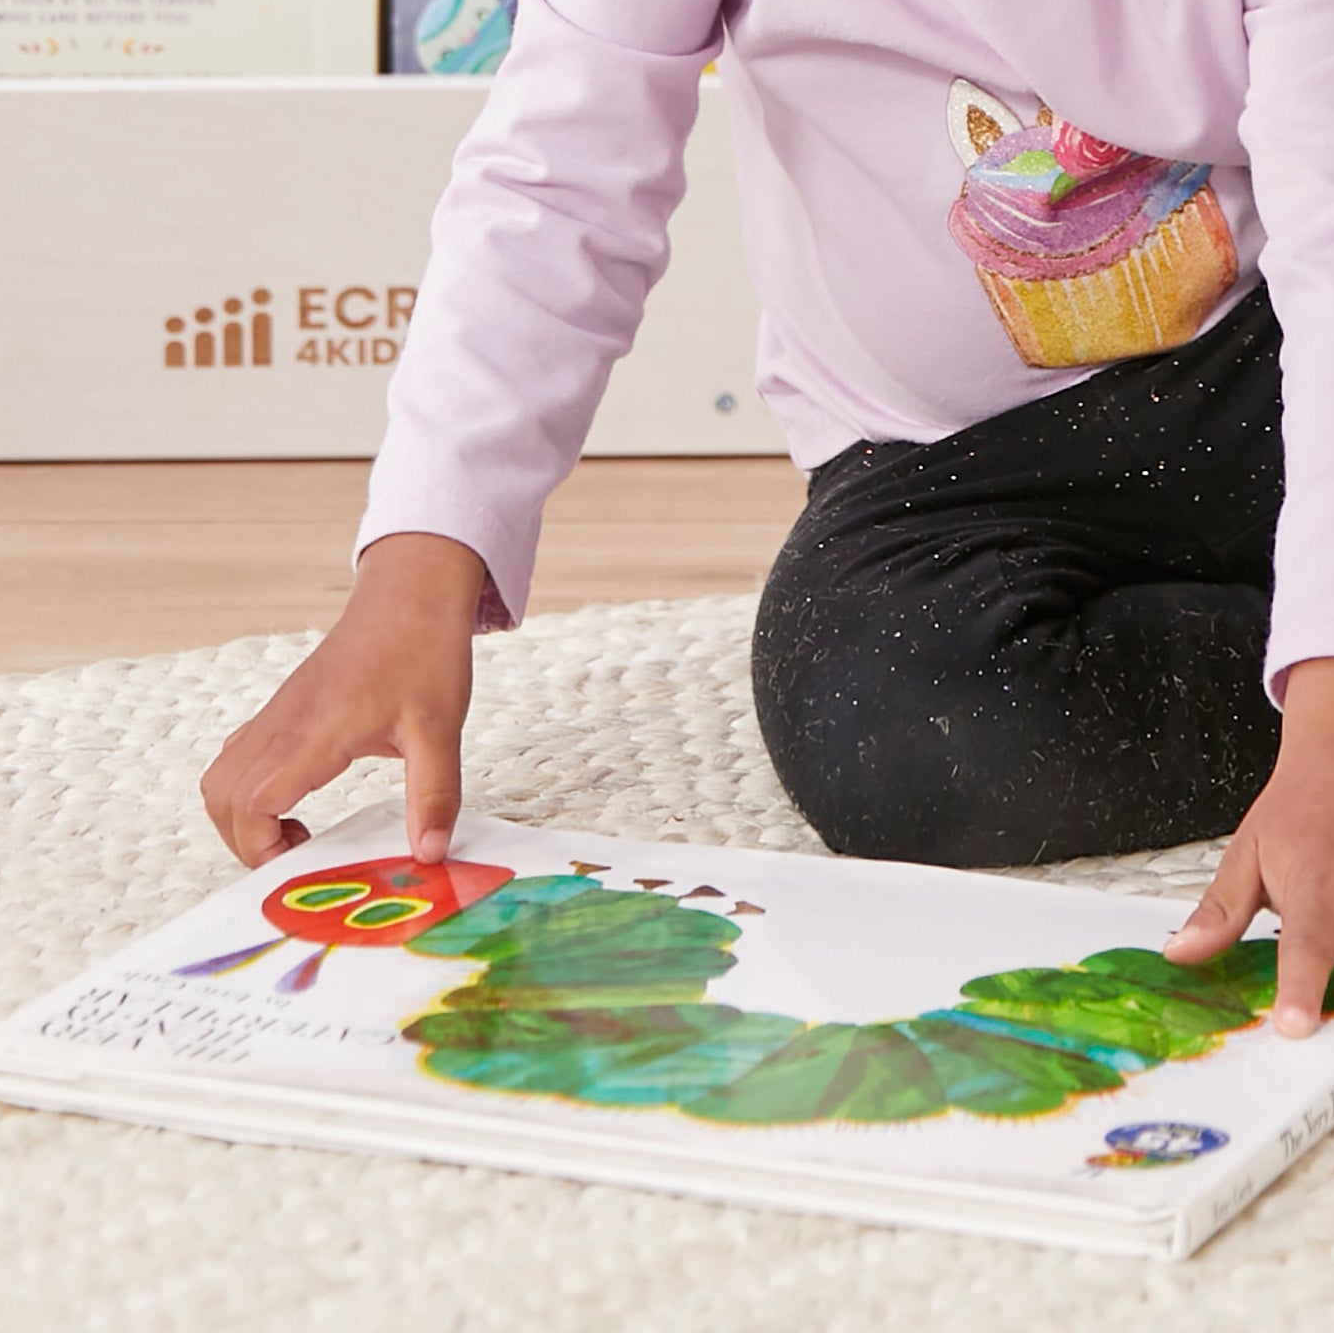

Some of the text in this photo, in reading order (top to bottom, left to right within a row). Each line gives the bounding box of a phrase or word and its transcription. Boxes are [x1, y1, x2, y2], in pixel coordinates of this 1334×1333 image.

[297, 286, 419, 331] ECR
[295, 337, 401, 367] 4KID
[1280, 1125, 1304, 1161] The
